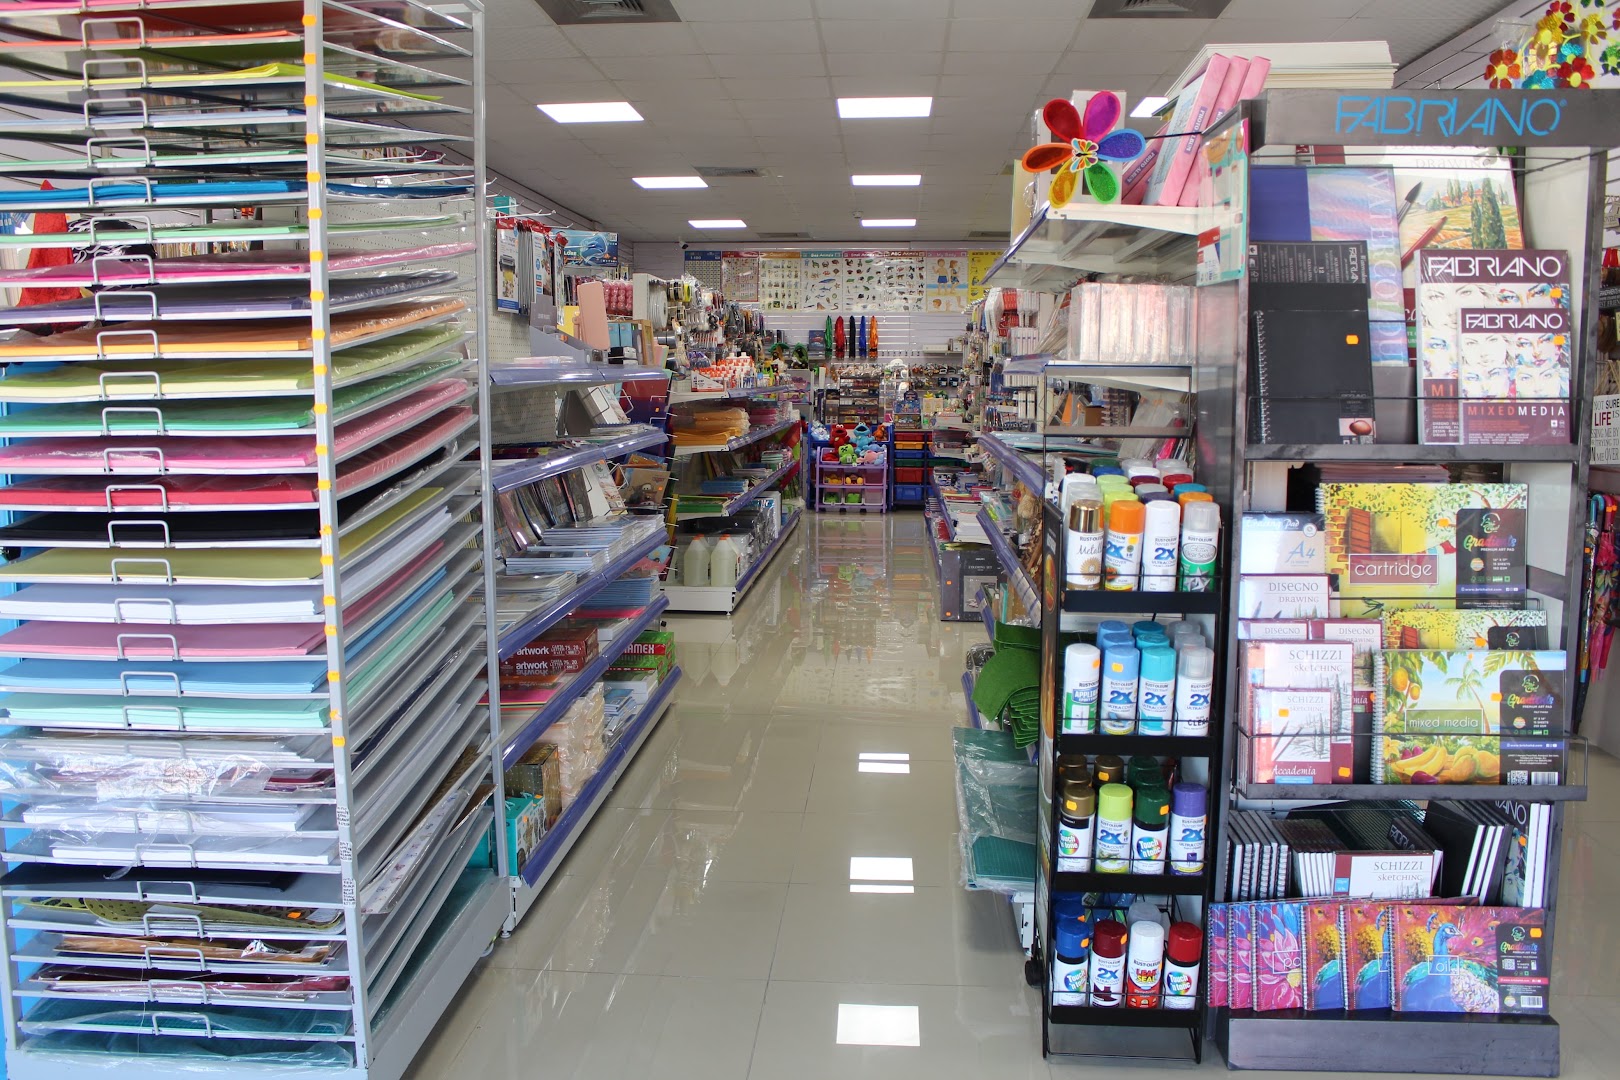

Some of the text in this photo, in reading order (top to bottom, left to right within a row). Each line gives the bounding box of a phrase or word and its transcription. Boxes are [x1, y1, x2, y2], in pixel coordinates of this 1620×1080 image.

[1335, 96, 1561, 137] FABRIANO
[1367, 170, 1405, 366] WATERCOLOU
[1428, 256, 1562, 278] FABRIANO
[1466, 313, 1563, 329] FABRIANO
[1605, 399, 1620, 410] SURE
[1594, 411, 1612, 427] LIFE
[1154, 547, 1176, 560] 2X
[1285, 541, 1316, 563] A4
[1354, 559, 1433, 578] cartridge
[516, 646, 550, 656] artwork
[624, 643, 655, 654] AMEX
[1288, 650, 1343, 661] SCHIZZI
[515, 660, 548, 670] artwork
[1109, 690, 1133, 704] 2X
[1144, 691, 1167, 706] 2X
[1189, 693, 1210, 707] 2X
[1287, 695, 1324, 704] SCHIZZI
[1409, 716, 1479, 728] mixed media
[1272, 765, 1317, 776] Accademia
[1099, 829, 1122, 844] 2X
[1181, 828, 1204, 842] 2X
[1139, 838, 1159, 849] Touch
[1374, 861, 1424, 871] SCHIZZI
[1435, 959, 1451, 972] oil
[1066, 970, 1086, 983] Touch
[1097, 967, 1119, 980] 2X
[1136, 975, 1156, 983] SEAL
[1168, 973, 1189, 983] Touch
[1176, 982, 1191, 991] tone
